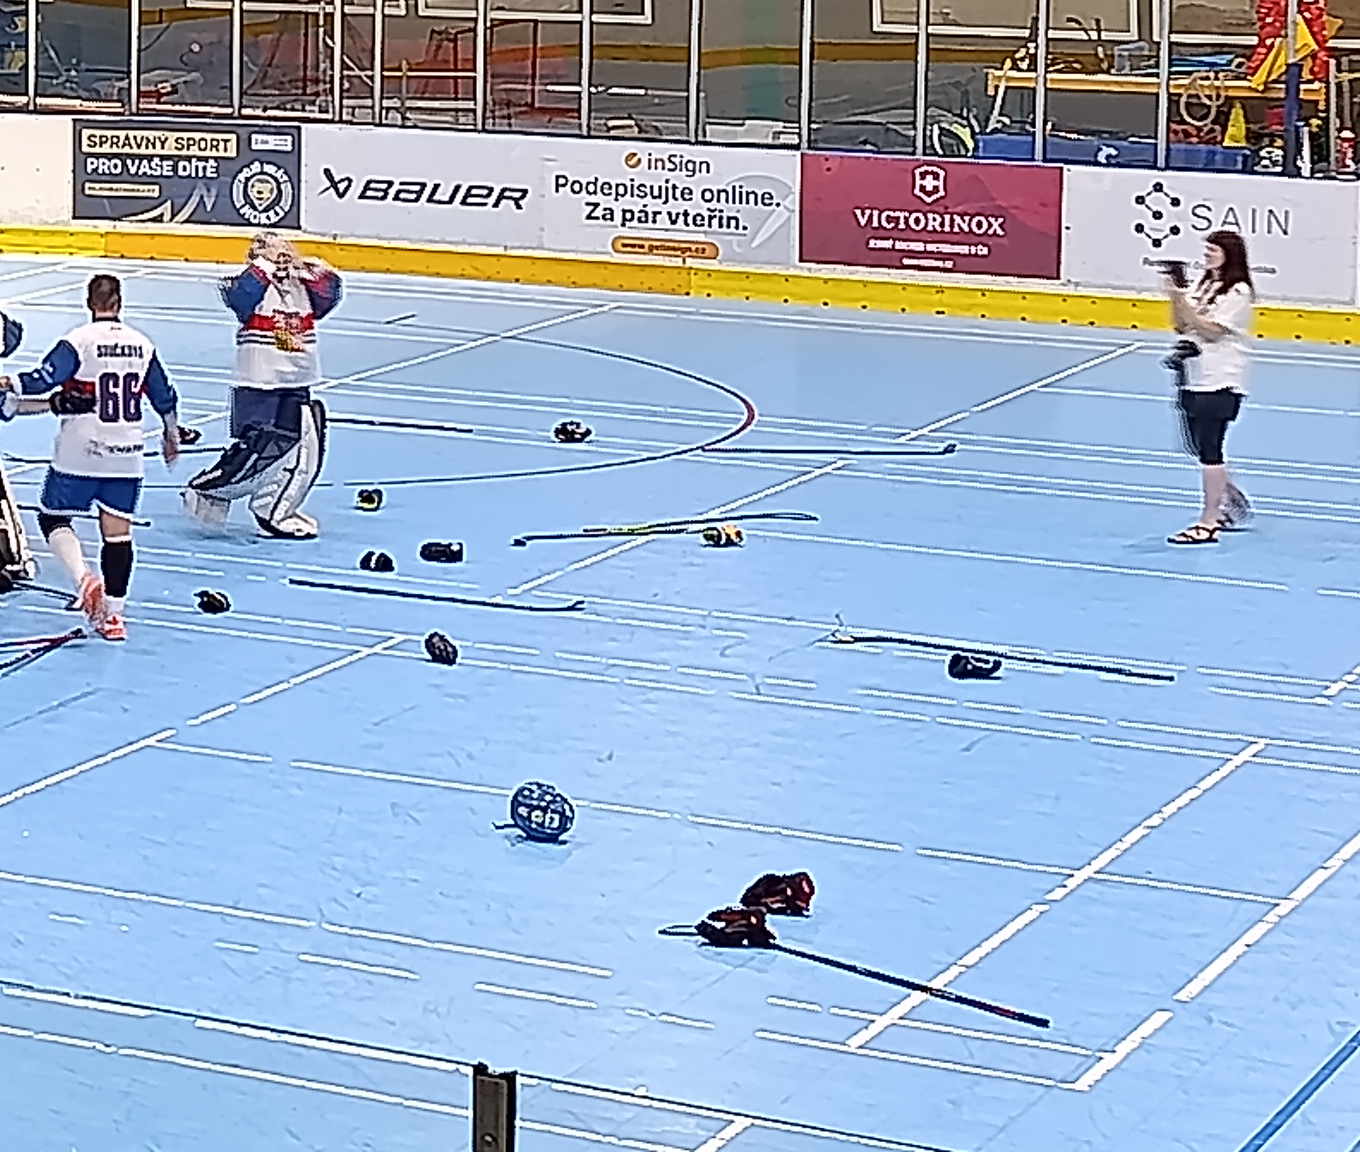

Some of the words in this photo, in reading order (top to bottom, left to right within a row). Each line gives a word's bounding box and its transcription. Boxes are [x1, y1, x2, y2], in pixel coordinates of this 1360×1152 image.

[86, 132, 169, 151] SPRÁVNÝ
[173, 135, 234, 154] SPORT
[86, 157, 122, 175] PRO
[126, 156, 174, 177] VAŠE
[177, 157, 218, 178] DÍTĚ
[647, 153, 711, 177] inSign
[554, 175, 694, 205] Podepisujte
[701, 185, 782, 208] online.
[584, 202, 615, 222] Za
[621, 204, 662, 227] pár
[666, 207, 749, 231] vteřin.
[853, 208, 1006, 236] VICTORINOX
[1191, 204, 1290, 236] SAIN
[99, 372, 143, 423] 66
